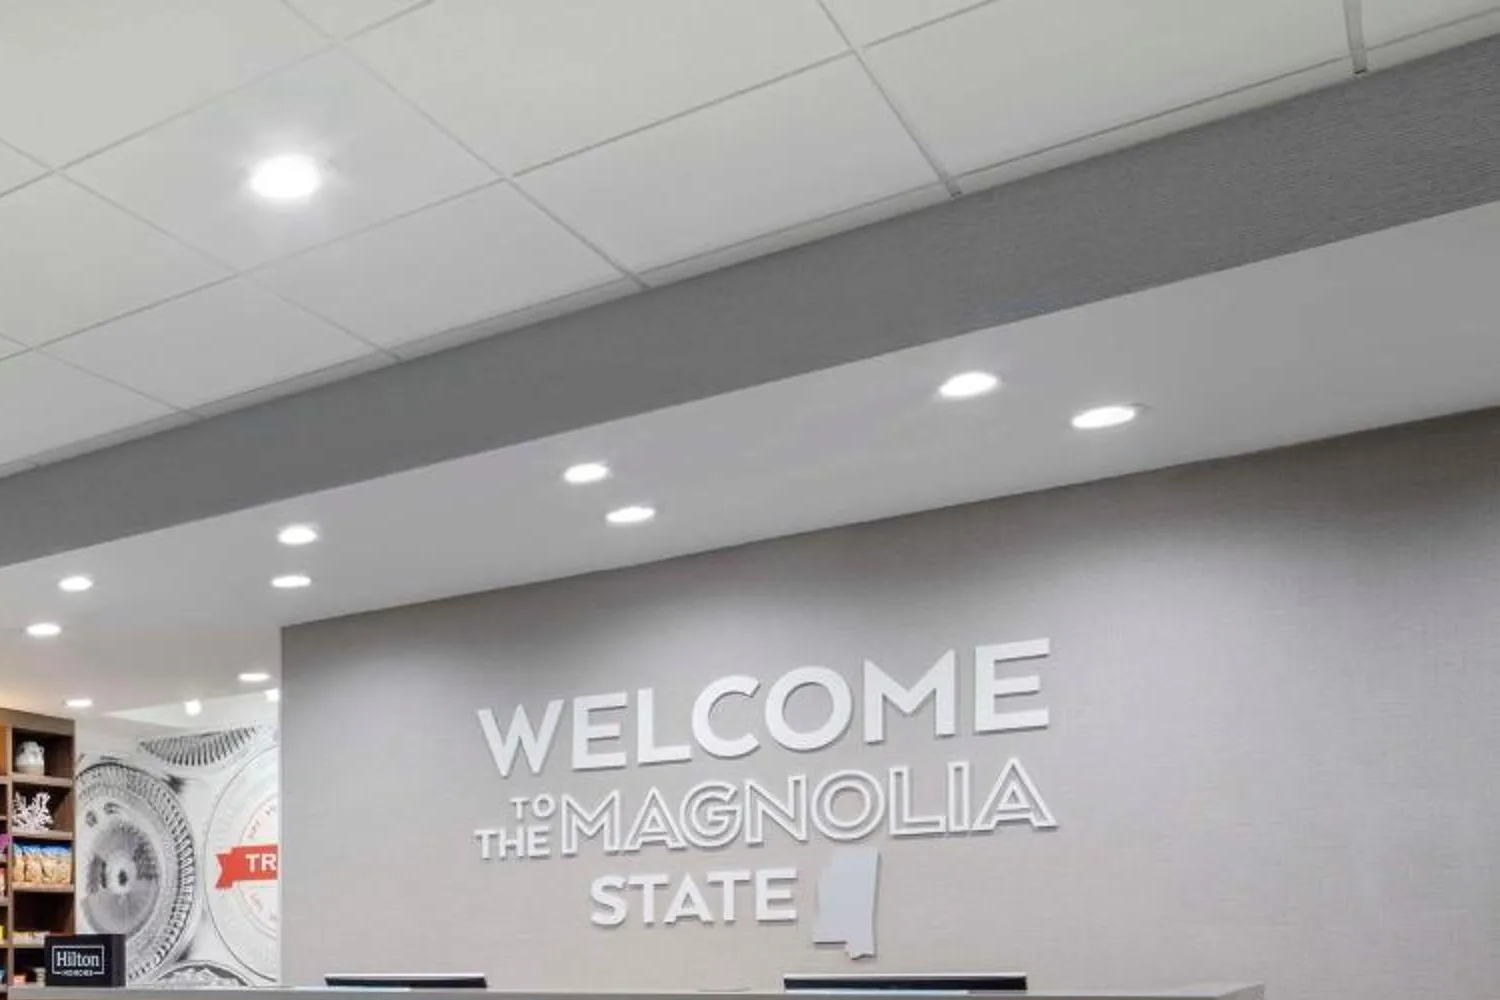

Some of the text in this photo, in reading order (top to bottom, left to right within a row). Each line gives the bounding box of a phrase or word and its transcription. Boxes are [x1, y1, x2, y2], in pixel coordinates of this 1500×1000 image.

[477, 638, 1050, 778] WELCOME
[473, 756, 1060, 861] THE MAGNOLIA
[509, 792, 556, 822] TO
[589, 867, 798, 928] STATE
[56, 951, 99, 967] Hilton
